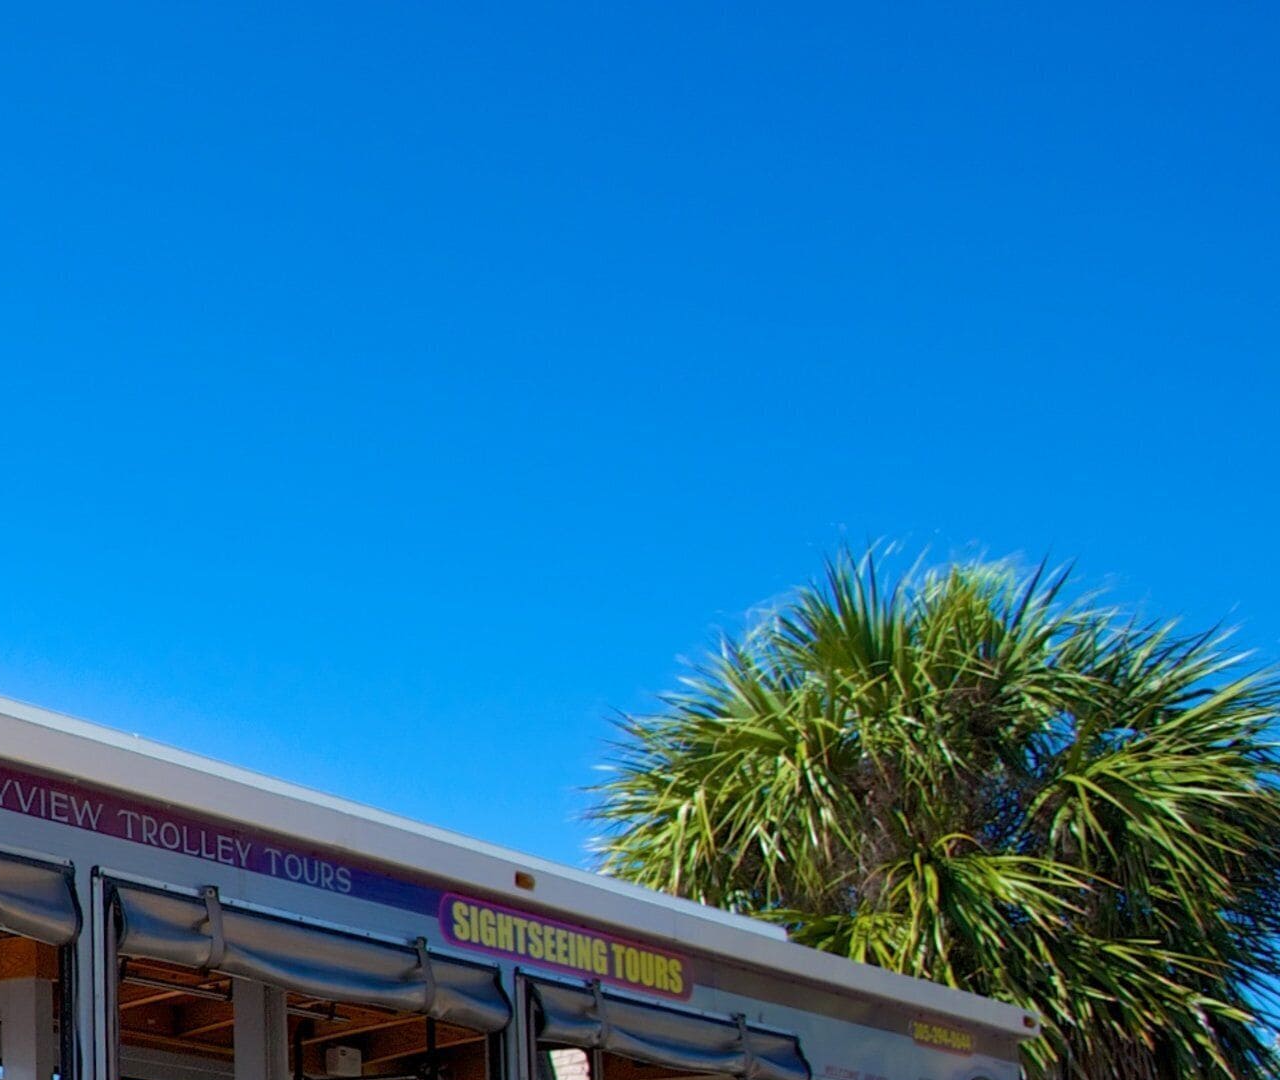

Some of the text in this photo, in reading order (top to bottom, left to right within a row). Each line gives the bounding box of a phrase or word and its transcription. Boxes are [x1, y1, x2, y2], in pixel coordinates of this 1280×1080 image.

[117, 809, 253, 867] TROLLEY
[264, 848, 352, 893] TOURS
[452, 900, 683, 994] SIGHTSEEING TOURS
